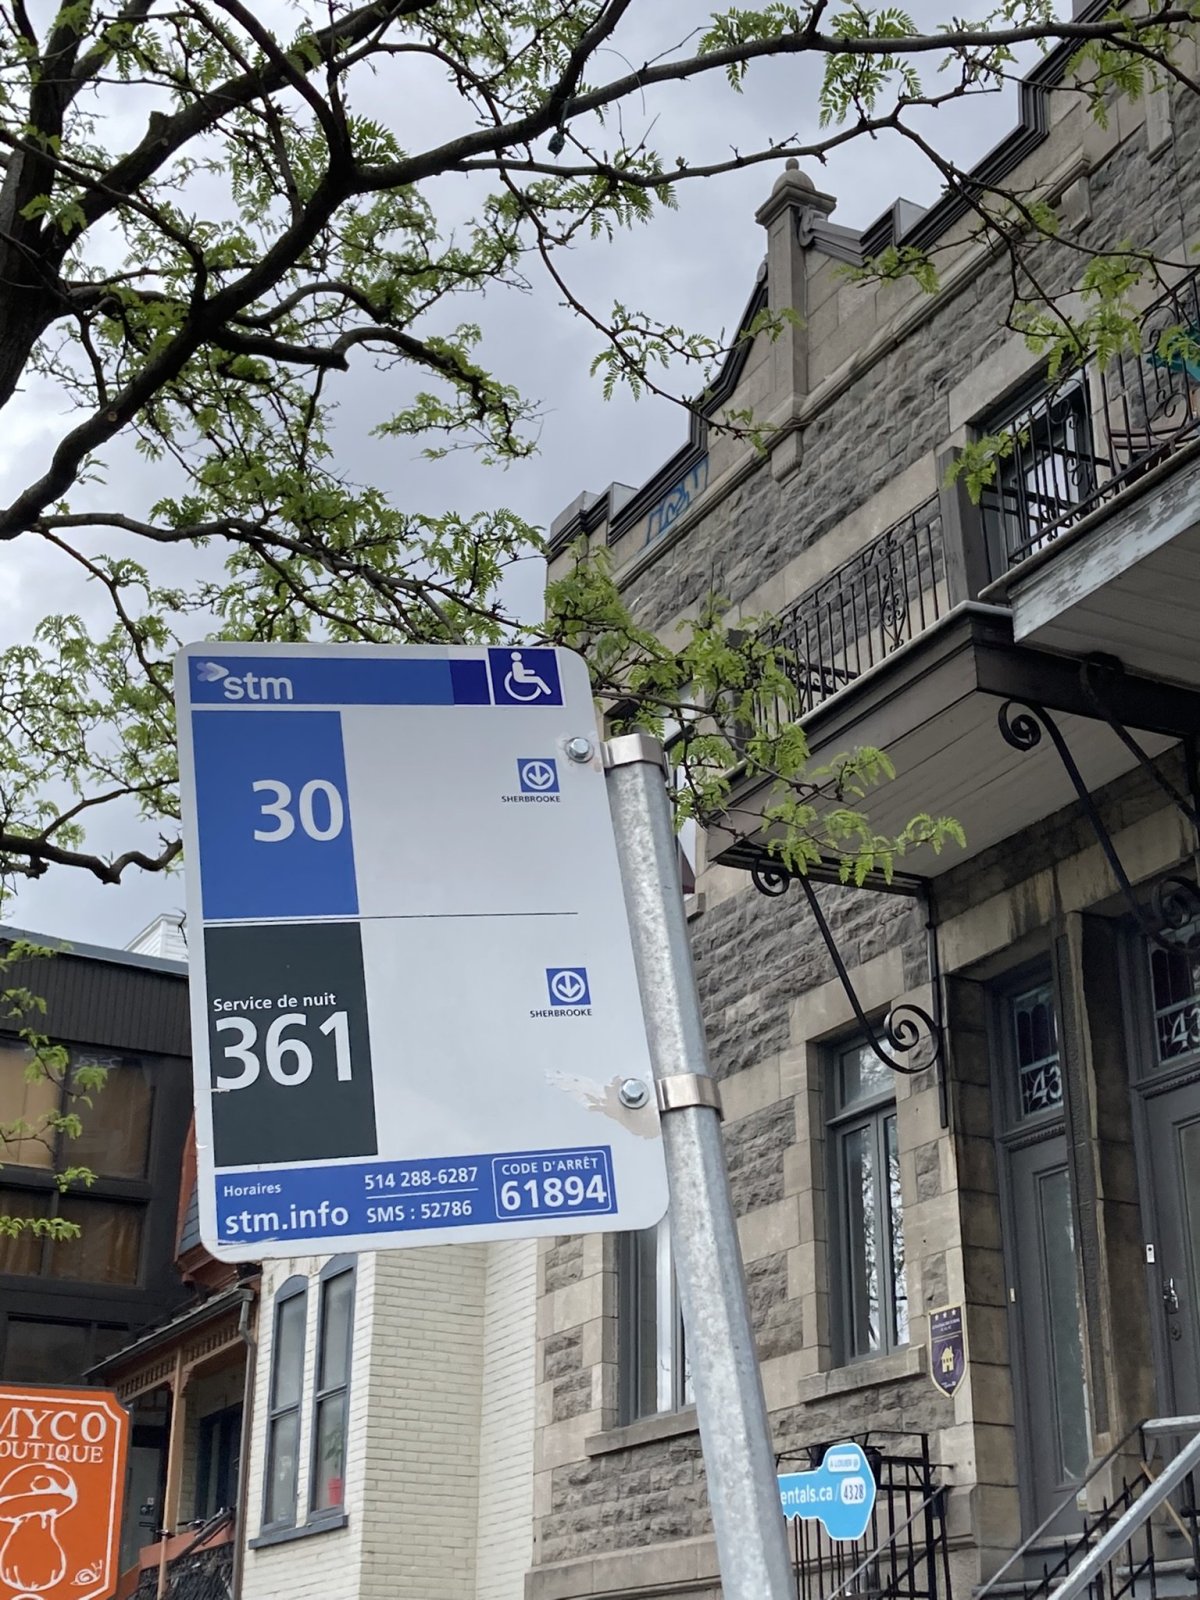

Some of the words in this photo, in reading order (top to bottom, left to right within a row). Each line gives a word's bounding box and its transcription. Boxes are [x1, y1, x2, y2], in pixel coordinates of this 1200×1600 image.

[223, 672, 293, 701] stm
[252, 779, 343, 842] 30
[501, 795, 562, 803] SHERBROOKE
[214, 999, 272, 1012] Service
[278, 998, 298, 1009] de
[303, 994, 337, 1007] nuit
[530, 1009, 594, 1019] SHERBROOKE
[216, 1011, 351, 1091] 361
[502, 1162, 538, 1175] CODE
[542, 1156, 598, 1172] D'ARRÊT
[224, 1182, 281, 1197] Horaires
[365, 1173, 395, 1190] 514
[400, 1167, 478, 1187] 288-6287
[500, 1175, 607, 1211] 61894
[225, 1202, 349, 1234] stm.info
[366, 1206, 405, 1223] SMS
[420, 1200, 472, 1219] 52786
[844, 1485, 865, 1500] 4328
